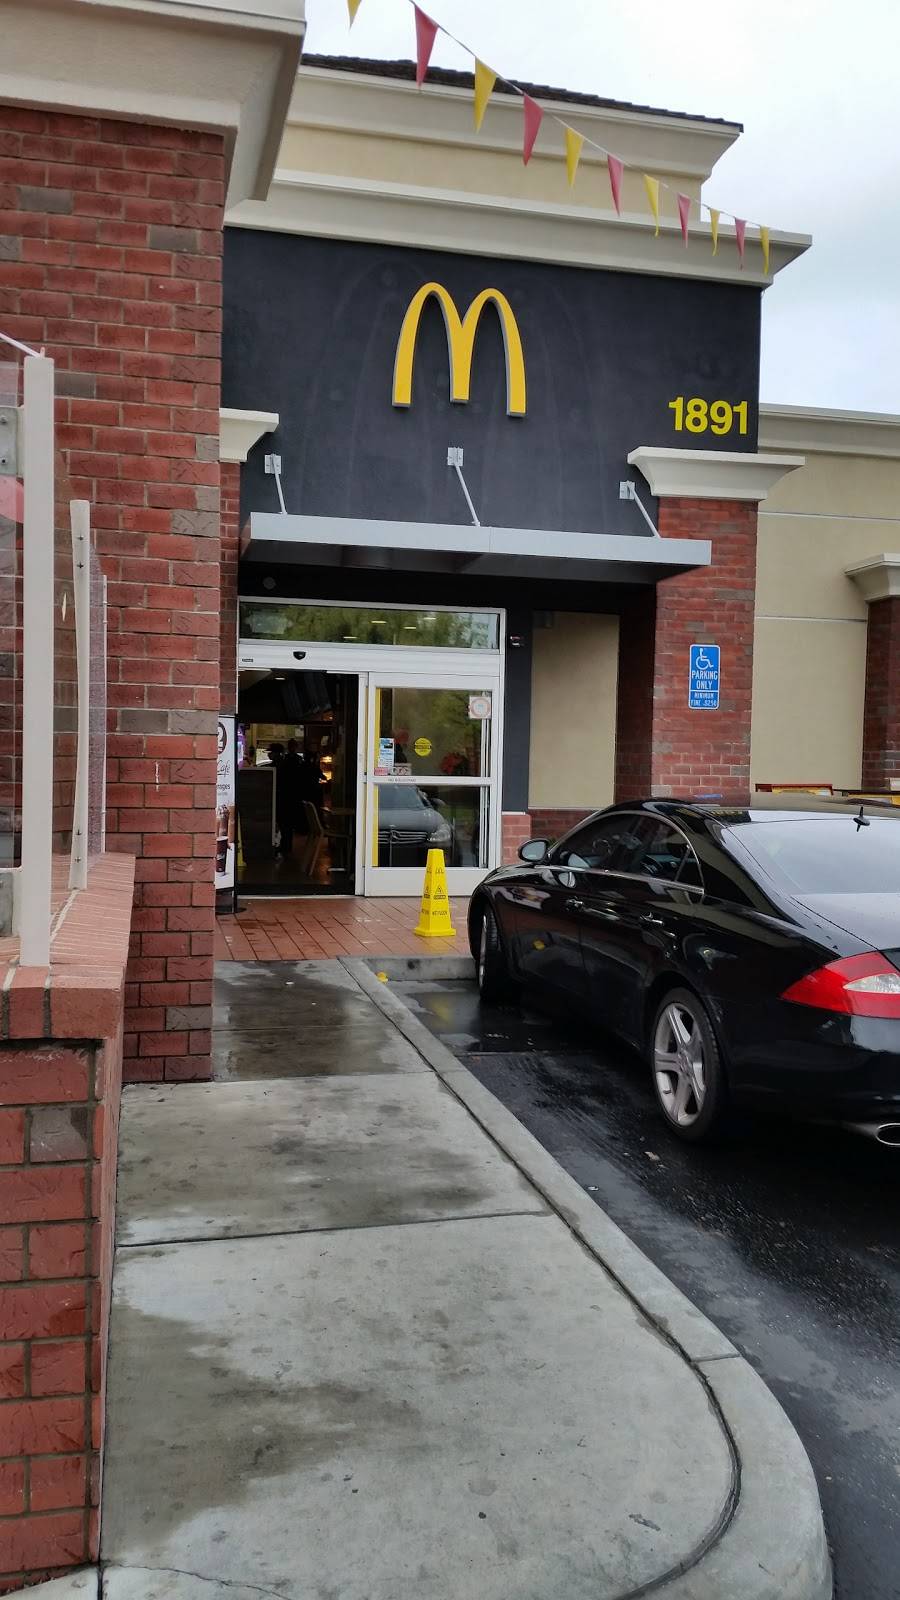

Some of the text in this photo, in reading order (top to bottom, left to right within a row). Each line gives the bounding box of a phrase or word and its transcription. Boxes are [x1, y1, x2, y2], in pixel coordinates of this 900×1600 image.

[392, 281, 526, 417] M
[668, 396, 748, 435] 1891
[692, 671, 718, 680] PARKING
[696, 680, 713, 690] ONLY
